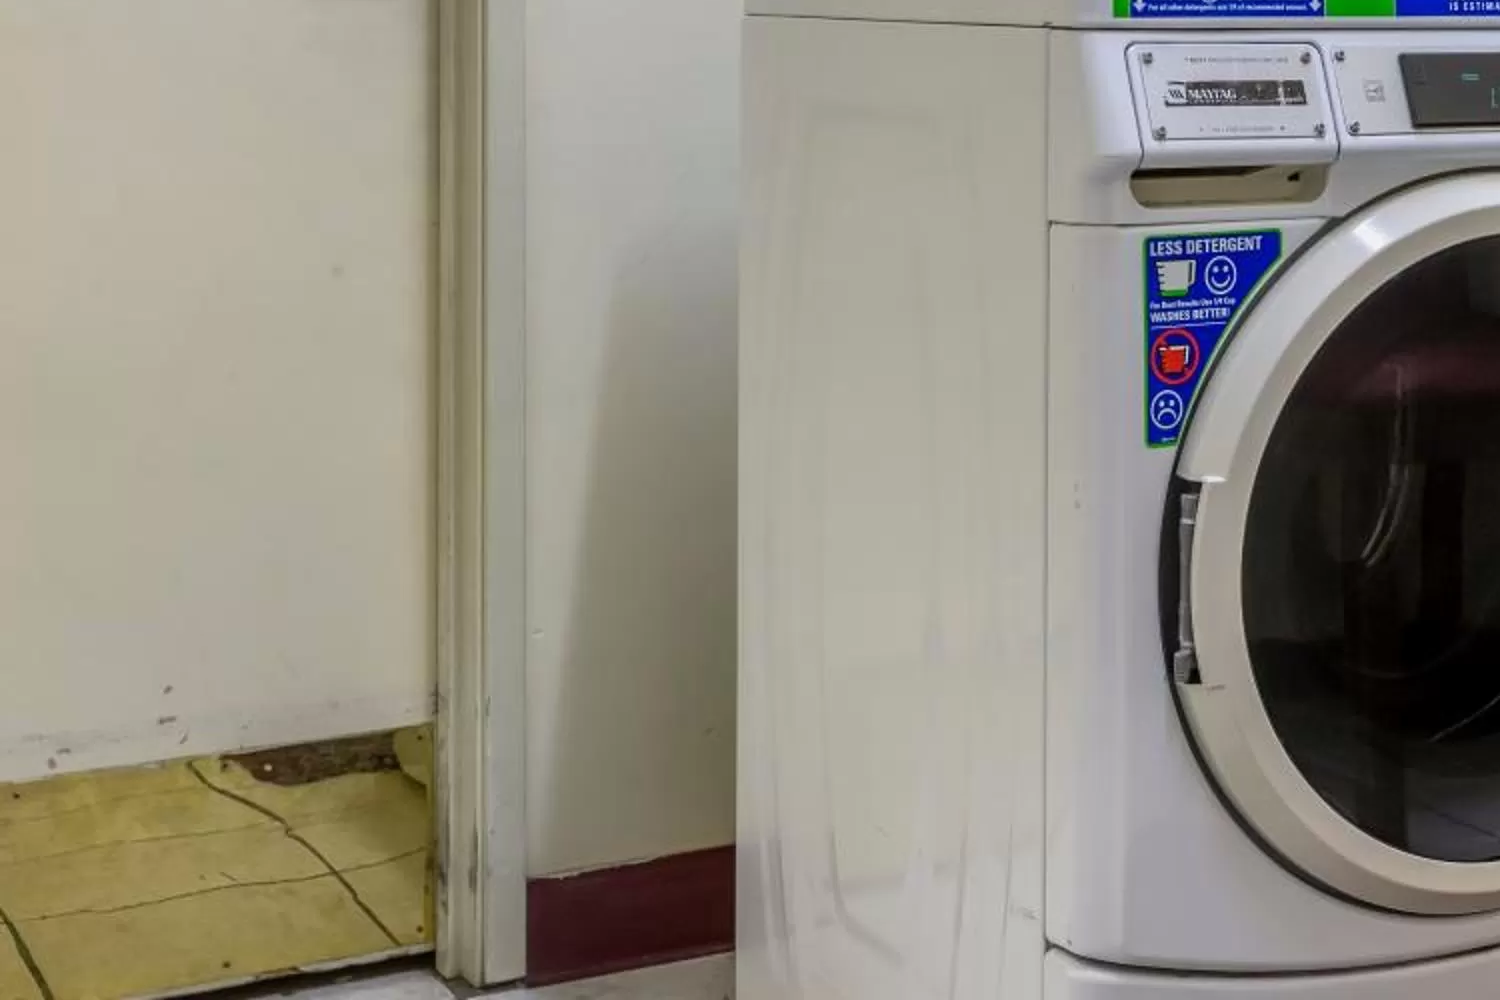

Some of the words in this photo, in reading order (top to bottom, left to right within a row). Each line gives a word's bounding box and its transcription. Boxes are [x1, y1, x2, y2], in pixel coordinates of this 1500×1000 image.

[1449, 1, 1459, 11] IS
[1187, 88, 1237, 100] MAYTAG
[1149, 241, 1183, 257] LESS
[1186, 236, 1263, 254] DETERGENT
[1150, 309, 1190, 323] WASHES
[1192, 308, 1231, 320] BETTER!
